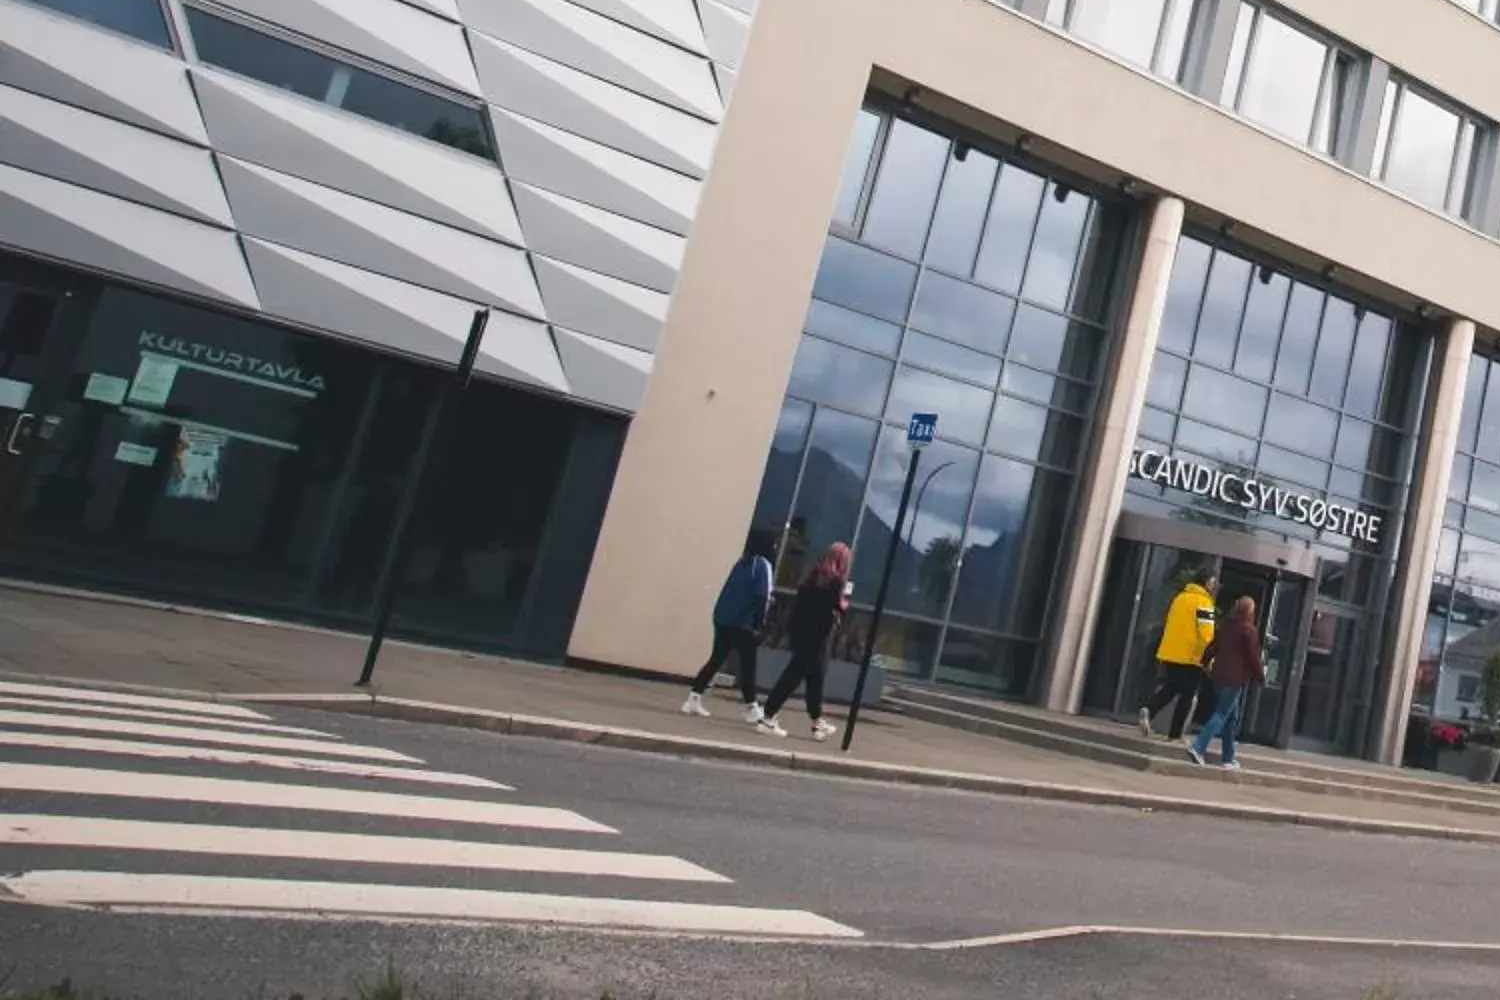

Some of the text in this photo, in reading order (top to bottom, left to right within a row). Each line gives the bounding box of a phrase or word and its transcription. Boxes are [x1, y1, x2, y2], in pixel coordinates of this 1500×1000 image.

[139, 330, 326, 390] KULTURTAVLA
[1240, 479, 1290, 517] SYV
[1293, 495, 1382, 543] SØSTRE
